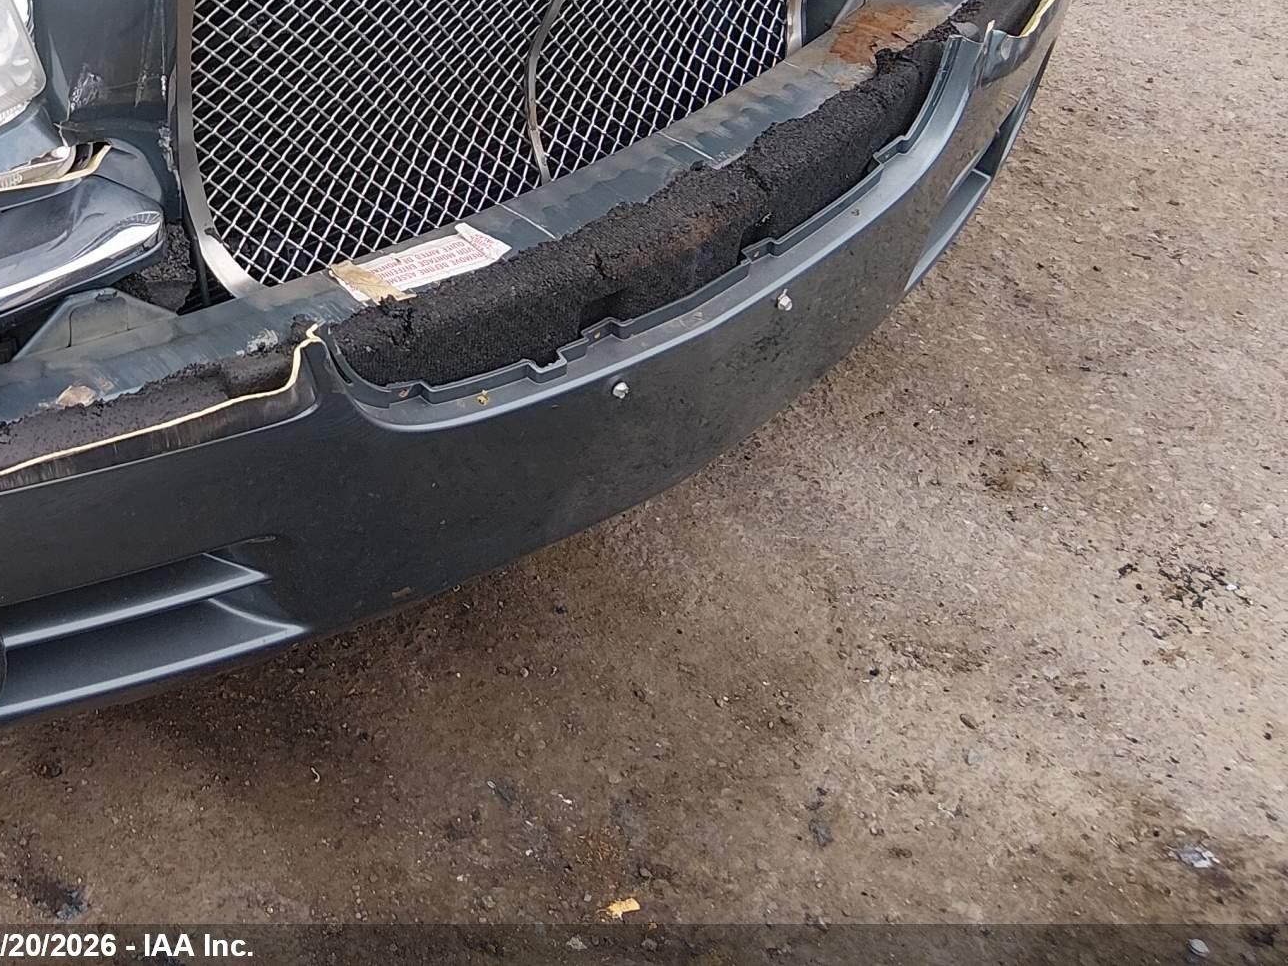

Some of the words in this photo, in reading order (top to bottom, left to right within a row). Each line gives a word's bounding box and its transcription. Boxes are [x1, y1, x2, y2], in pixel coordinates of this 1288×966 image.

[417, 251, 457, 267] MONTAGE
[448, 251, 484, 266] REMOVE
[416, 261, 450, 275] BEFORE
